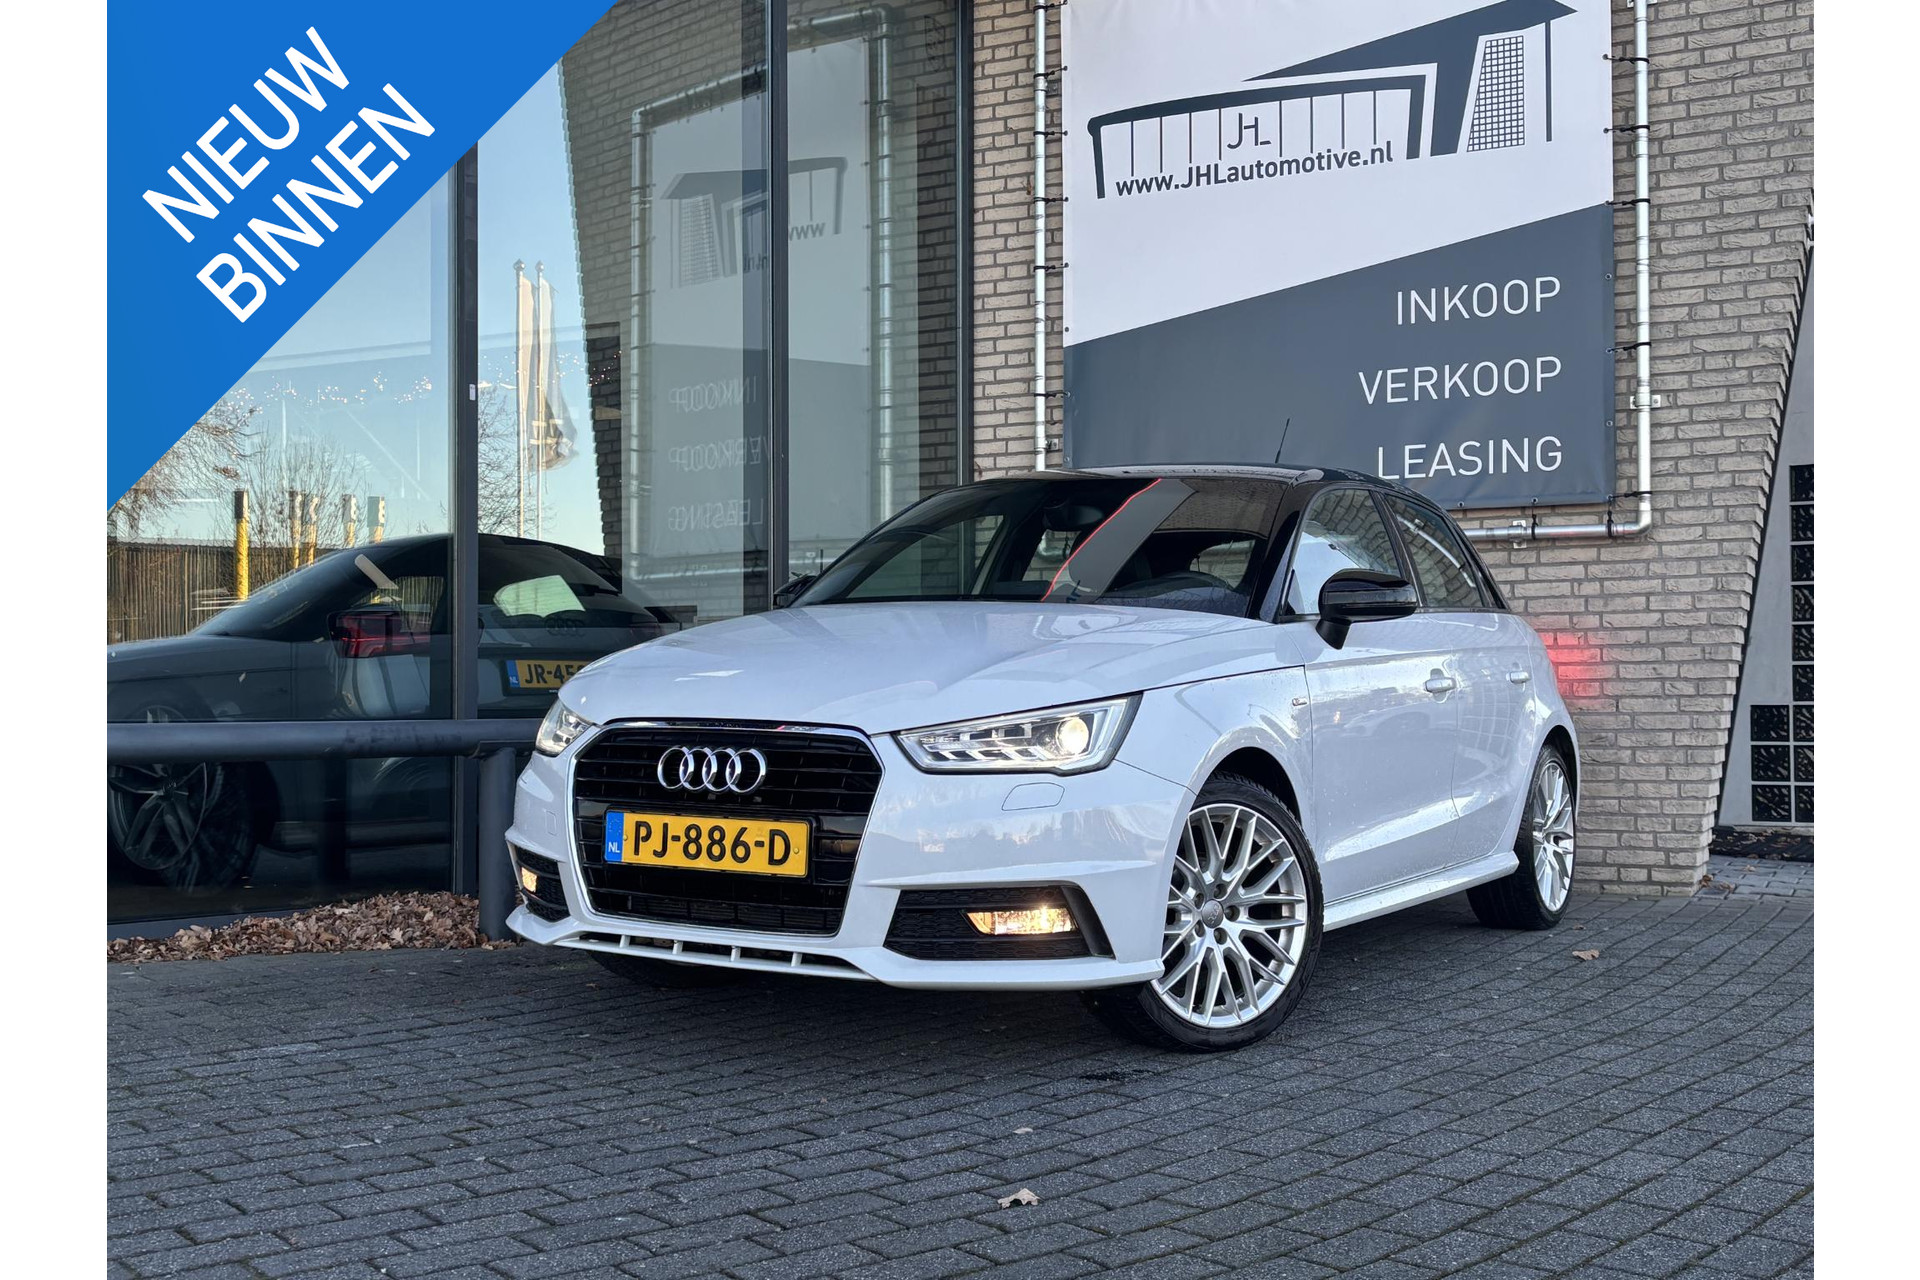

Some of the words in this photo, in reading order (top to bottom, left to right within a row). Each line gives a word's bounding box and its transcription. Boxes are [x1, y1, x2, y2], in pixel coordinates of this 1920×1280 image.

[1116, 141, 1392, 196] www.JHLautomotive.nl
[1398, 277, 1561, 325] INKOOP
[1359, 357, 1562, 404] VERKOOP
[1379, 436, 1562, 479] LEASING
[525, 664, 587, 684] JR-45
[608, 841, 621, 853] NL
[633, 820, 791, 866] PJ-886-D
